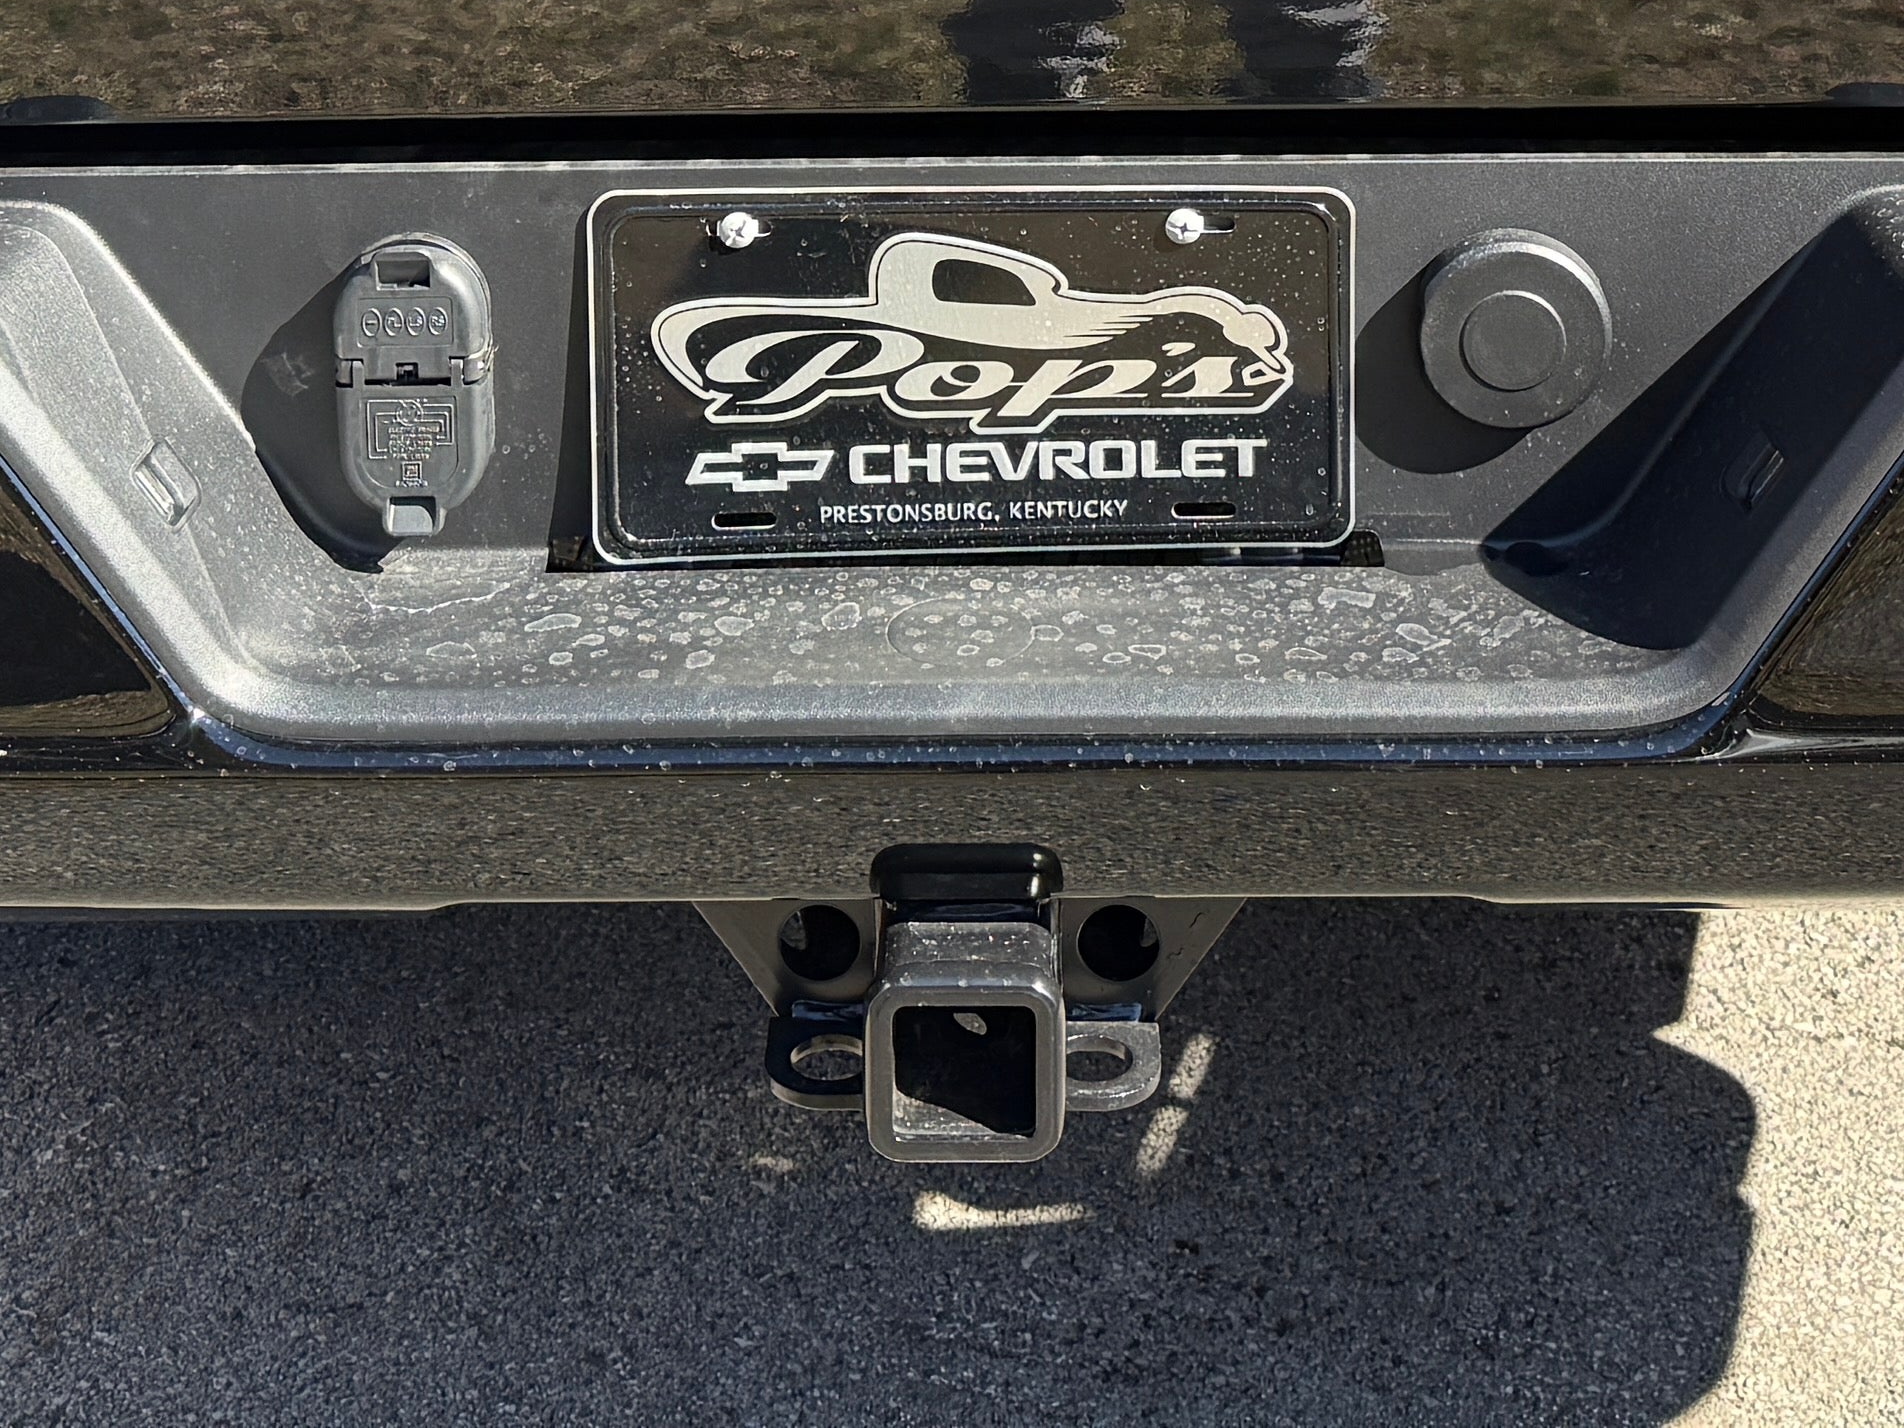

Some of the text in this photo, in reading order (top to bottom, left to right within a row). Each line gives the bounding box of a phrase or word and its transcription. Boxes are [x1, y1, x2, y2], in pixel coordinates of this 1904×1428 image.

[704, 328, 1256, 418] Pop's
[848, 438, 1269, 485] CHEVROLET
[818, 498, 1130, 524] PRESTONSBURG, KENTUCKY
